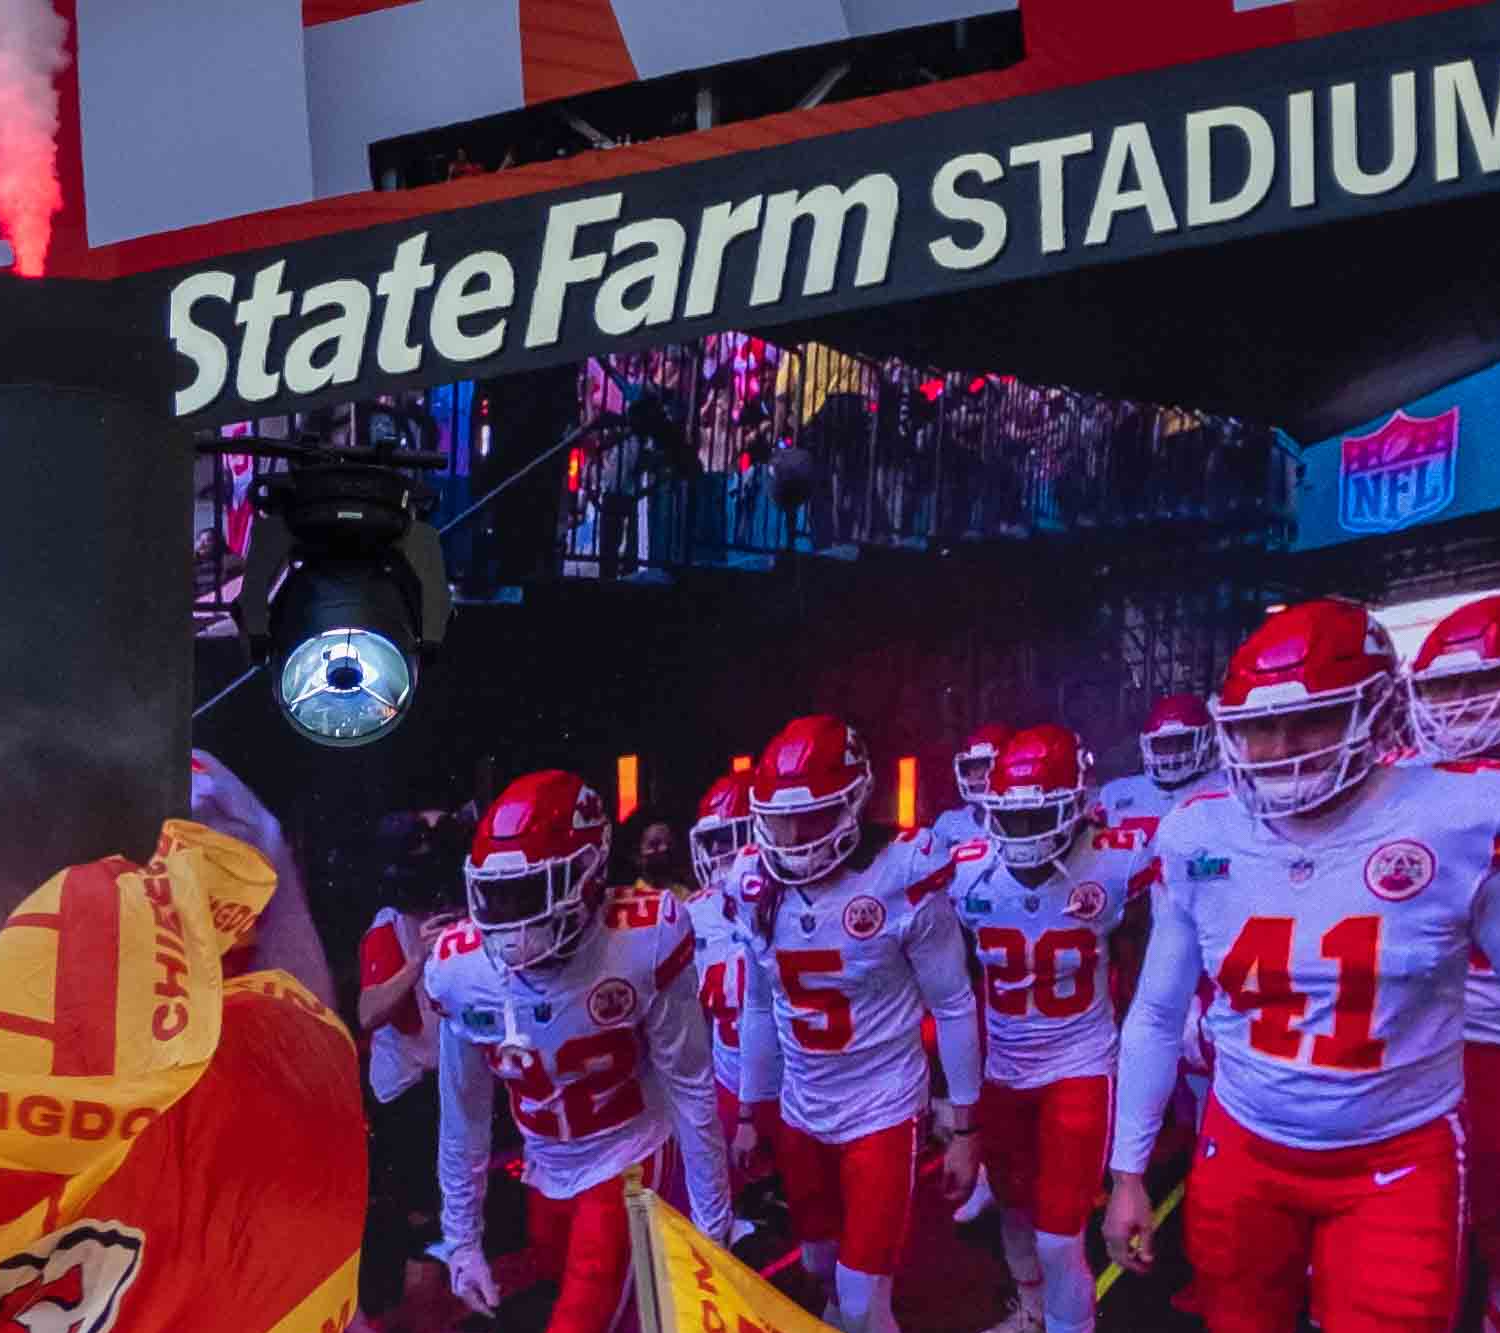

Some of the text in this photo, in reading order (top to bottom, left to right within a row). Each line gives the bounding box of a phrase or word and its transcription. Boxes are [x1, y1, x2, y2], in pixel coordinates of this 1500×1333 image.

[775, 947, 858, 1055] 5
[976, 926, 1100, 1019] 20
[1216, 914, 1387, 1072] 41
[484, 1022, 648, 1142] 22
